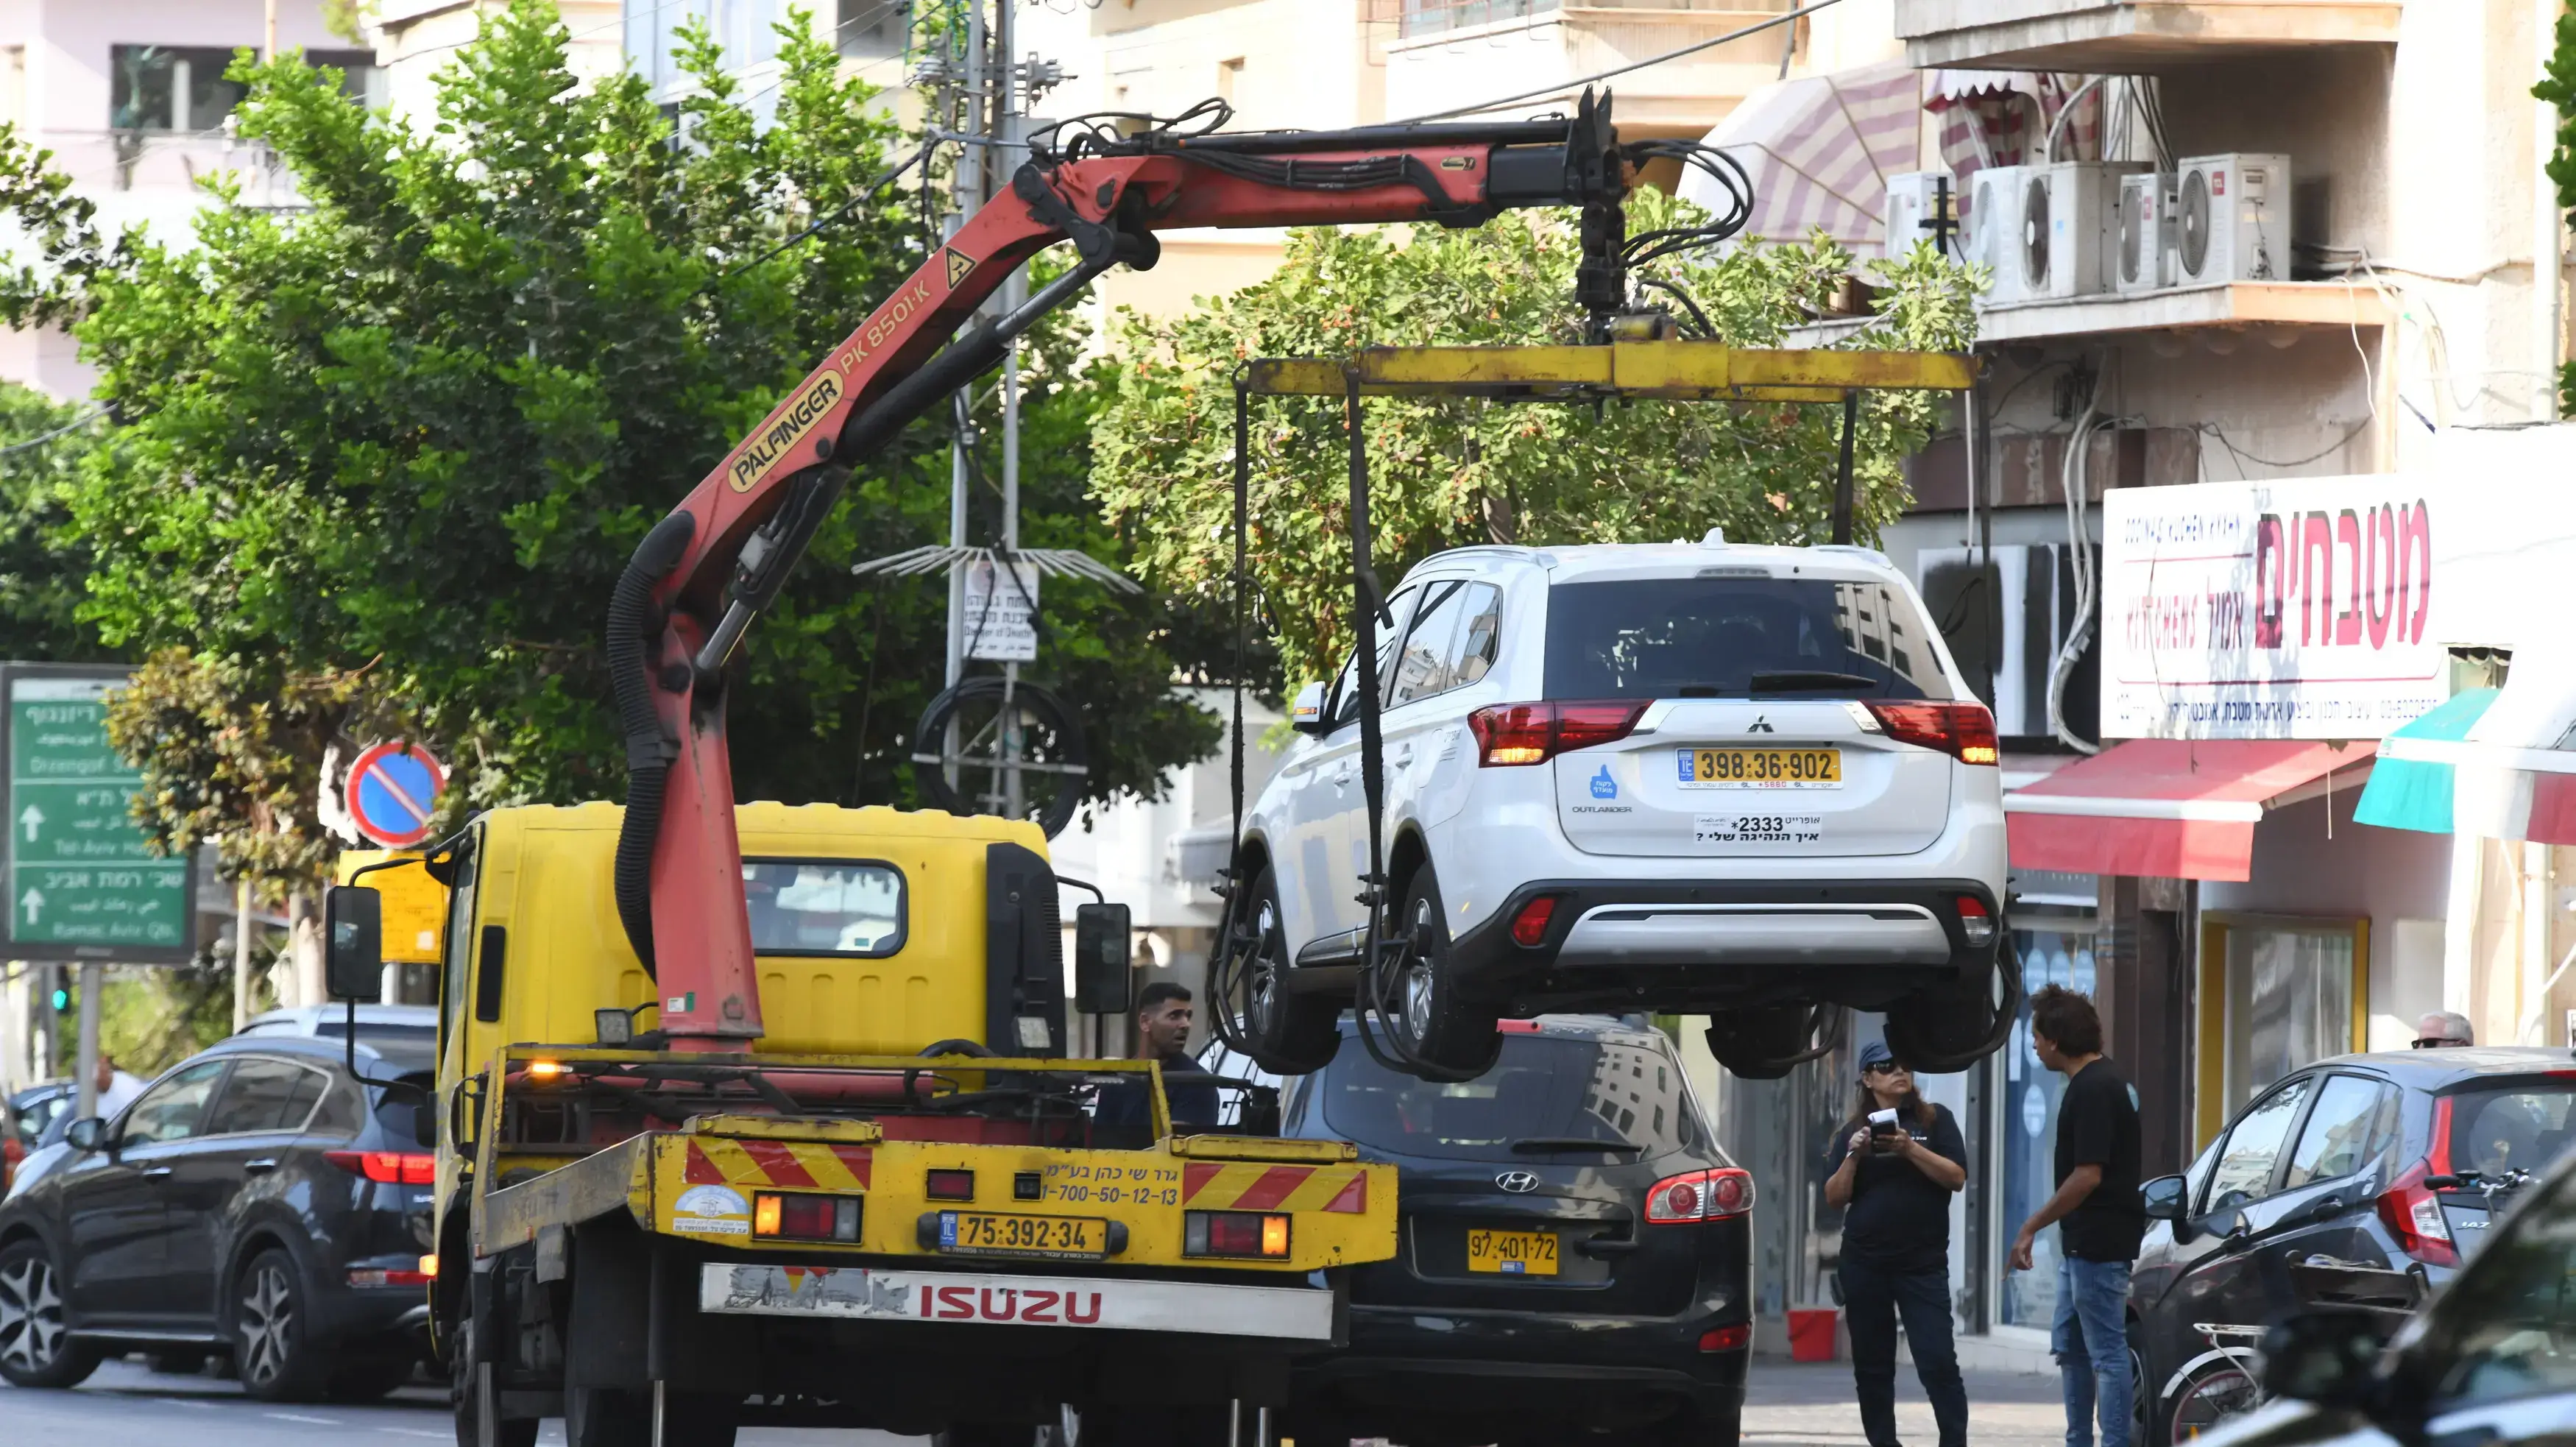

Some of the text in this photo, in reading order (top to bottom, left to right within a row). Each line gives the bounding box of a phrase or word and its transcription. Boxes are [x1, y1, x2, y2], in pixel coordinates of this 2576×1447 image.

[839, 339, 868, 375] PK
[735, 378, 838, 487] PALFINGER
[2255, 497, 2431, 650] מטבחים
[2126, 593, 2198, 651] KITCHENS
[1708, 832, 1736, 841] שלי
[1739, 832, 1791, 841] הנהיגה
[1795, 832, 1819, 843] איך
[44, 871, 91, 889] אביב
[98, 871, 142, 888] רמת
[1094, 1167, 1122, 1182] כהן
[1128, 1168, 1148, 1181] שי
[1153, 1169, 1178, 1181] גרר
[1041, 1184, 1178, 1206] 1-700-50-12-13
[920, 1284, 1102, 1325] ISUZU
